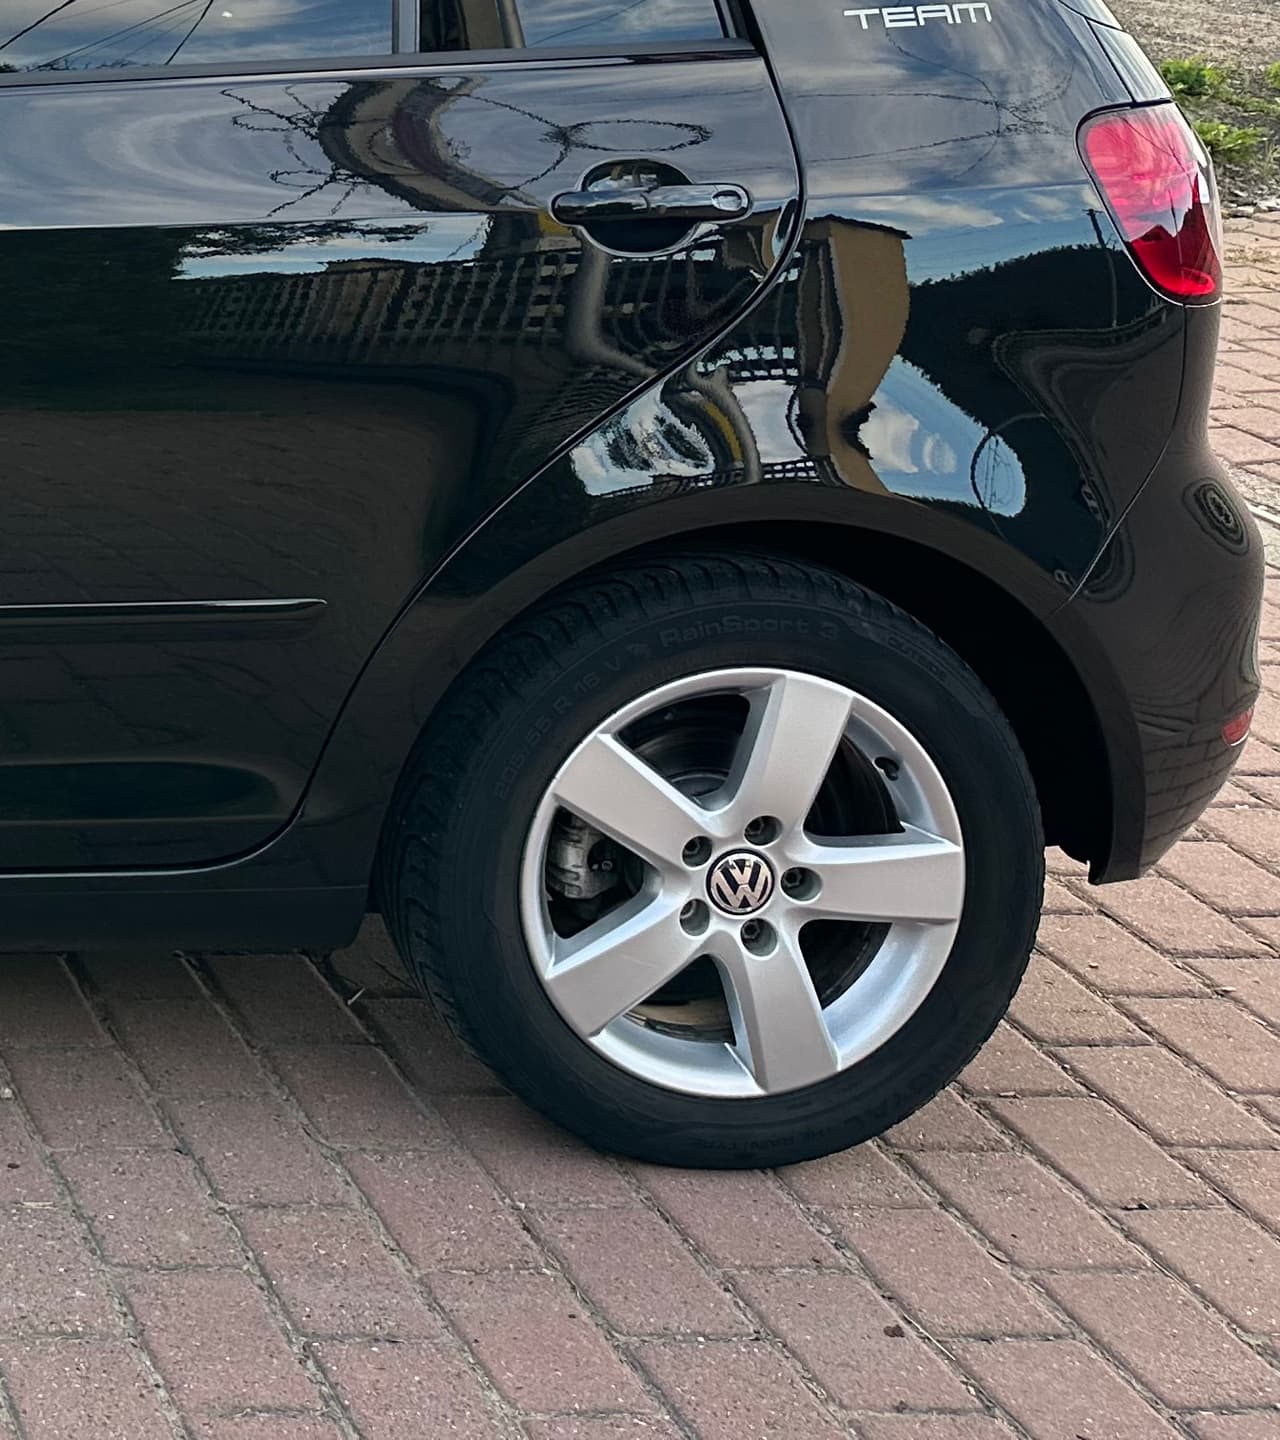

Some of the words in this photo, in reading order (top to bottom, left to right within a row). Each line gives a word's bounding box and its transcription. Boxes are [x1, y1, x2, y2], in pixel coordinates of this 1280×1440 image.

[843, 2, 993, 30] TEAM
[658, 614, 810, 649] RainSport
[817, 621, 841, 642] 3
